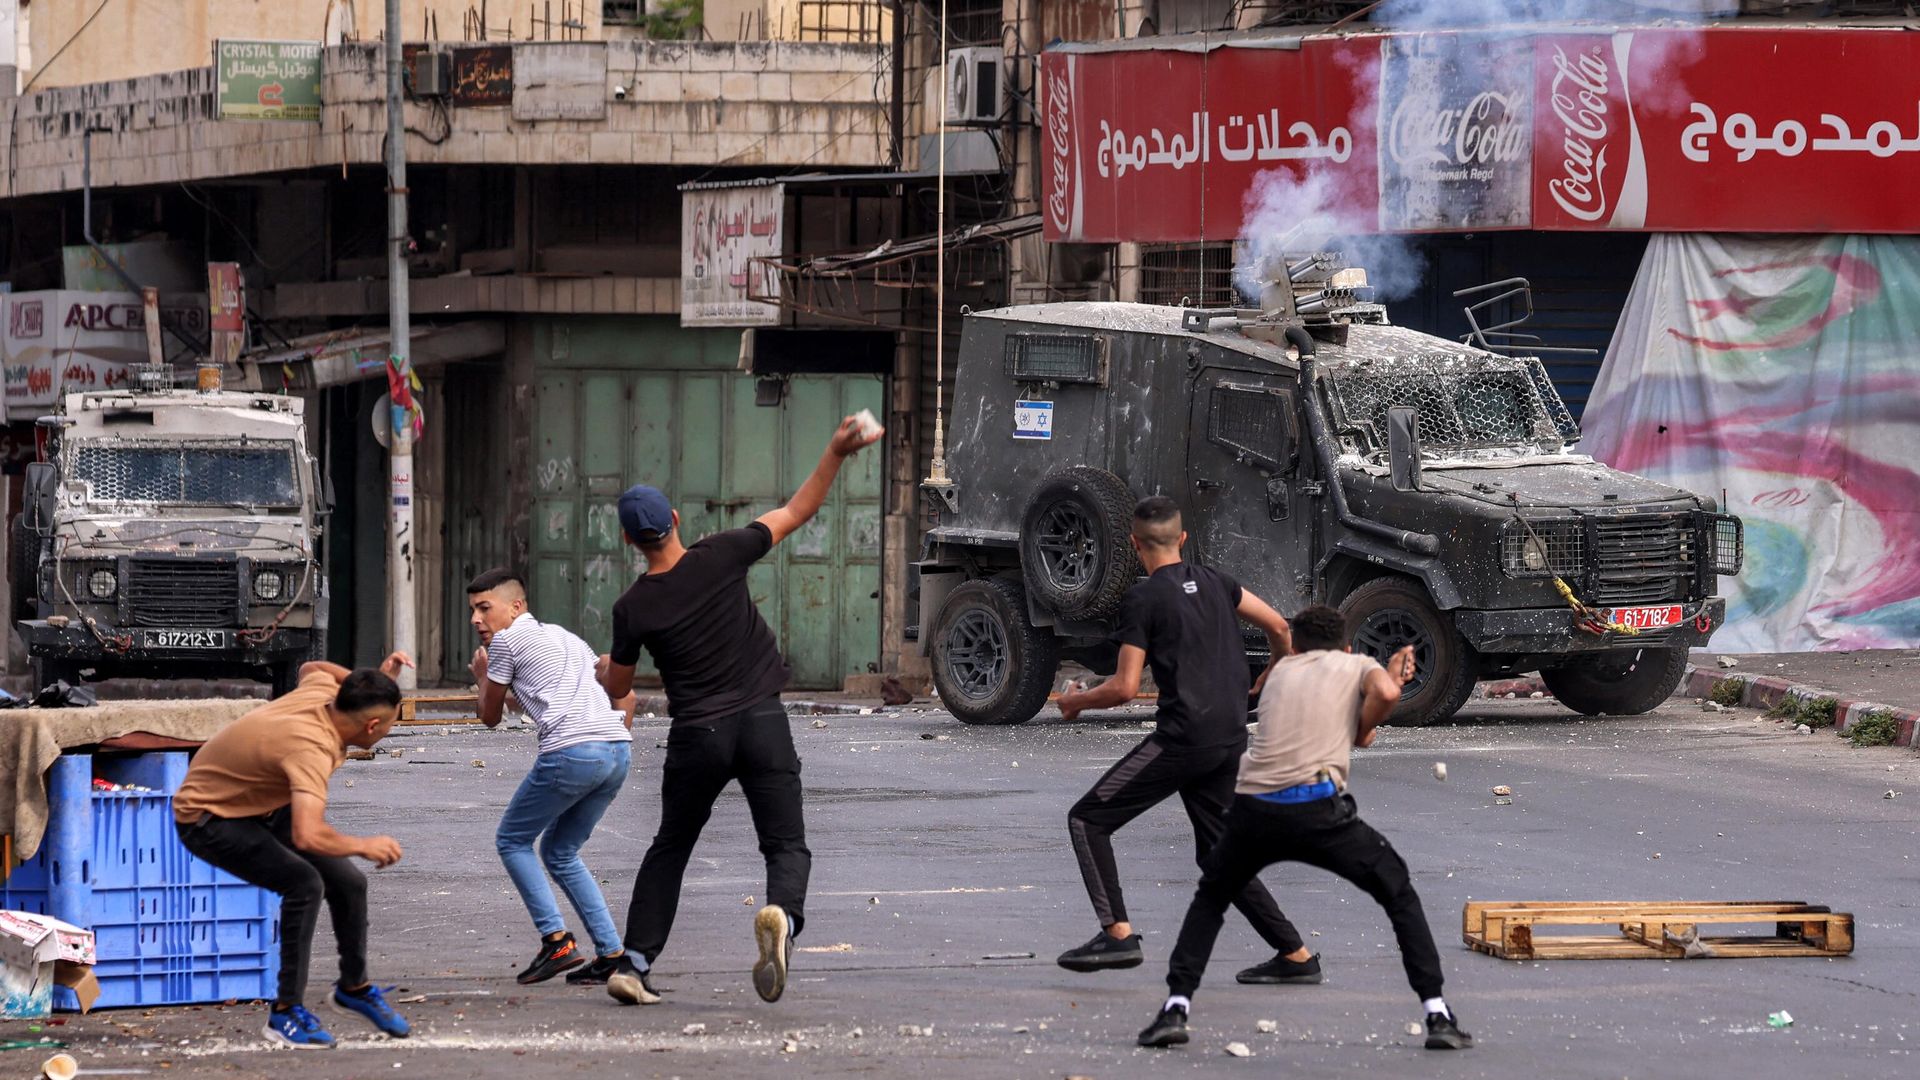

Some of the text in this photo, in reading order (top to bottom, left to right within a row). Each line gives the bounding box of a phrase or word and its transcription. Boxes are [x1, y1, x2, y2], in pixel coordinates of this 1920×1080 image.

[223, 45, 320, 59] CRYSTAL MOTEL
[227, 61, 315, 79] موتيل كريستال
[1098, 108, 1352, 178] محلات المدموج
[1389, 91, 1525, 164] Coca-Cola
[1549, 44, 1608, 221] Coca-Cola
[1681, 102, 1920, 163] مدموج
[1049, 66, 1069, 233] Coca-Cola
[1470, 168, 1494, 182] Regd
[64, 304, 122, 330] APC
[1624, 608, 1669, 627] 61-7182
